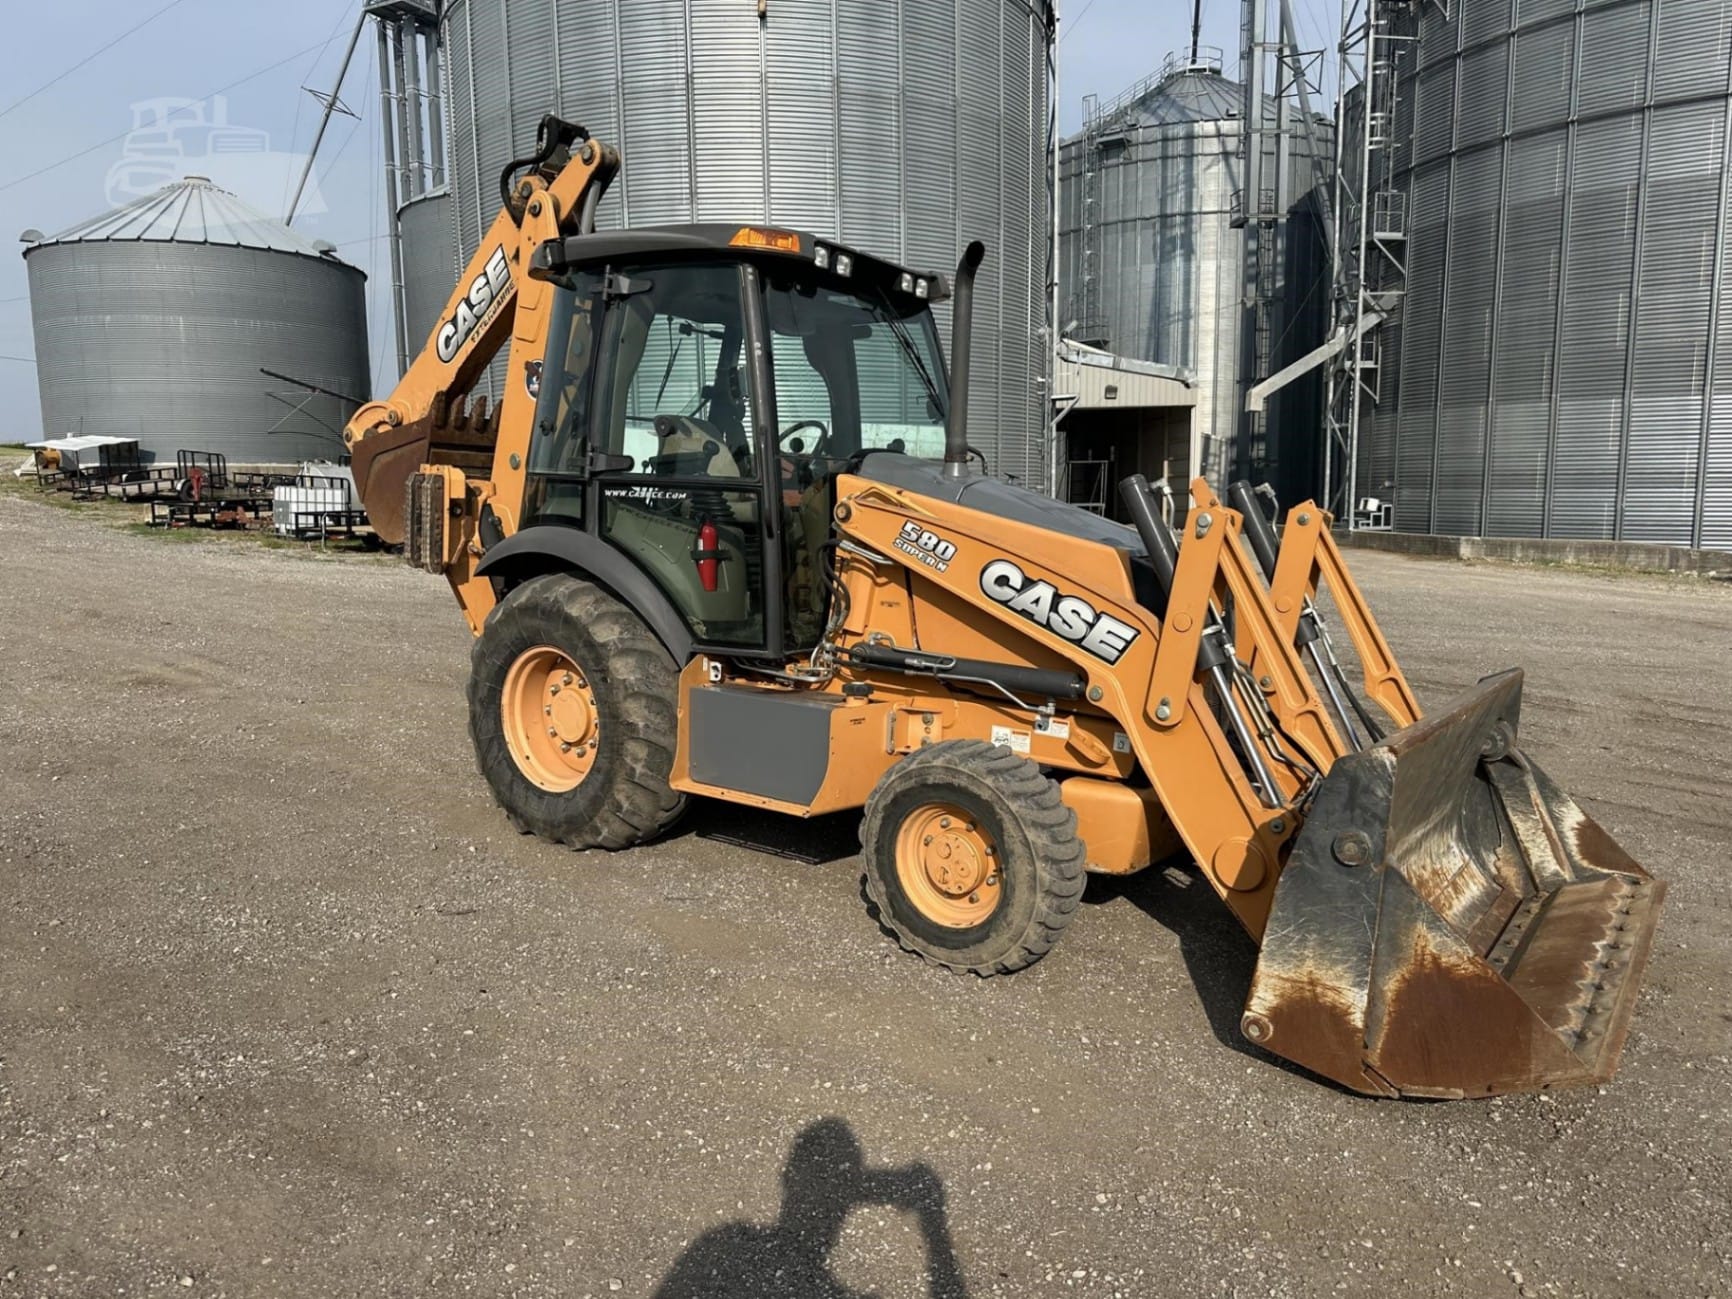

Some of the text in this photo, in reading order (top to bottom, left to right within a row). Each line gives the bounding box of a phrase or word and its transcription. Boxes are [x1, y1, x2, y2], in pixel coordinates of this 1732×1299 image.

[436, 243, 511, 363] CASE
[892, 537, 949, 573] SUPER N
[899, 519, 958, 562] 580
[980, 559, 1141, 665] CASE
